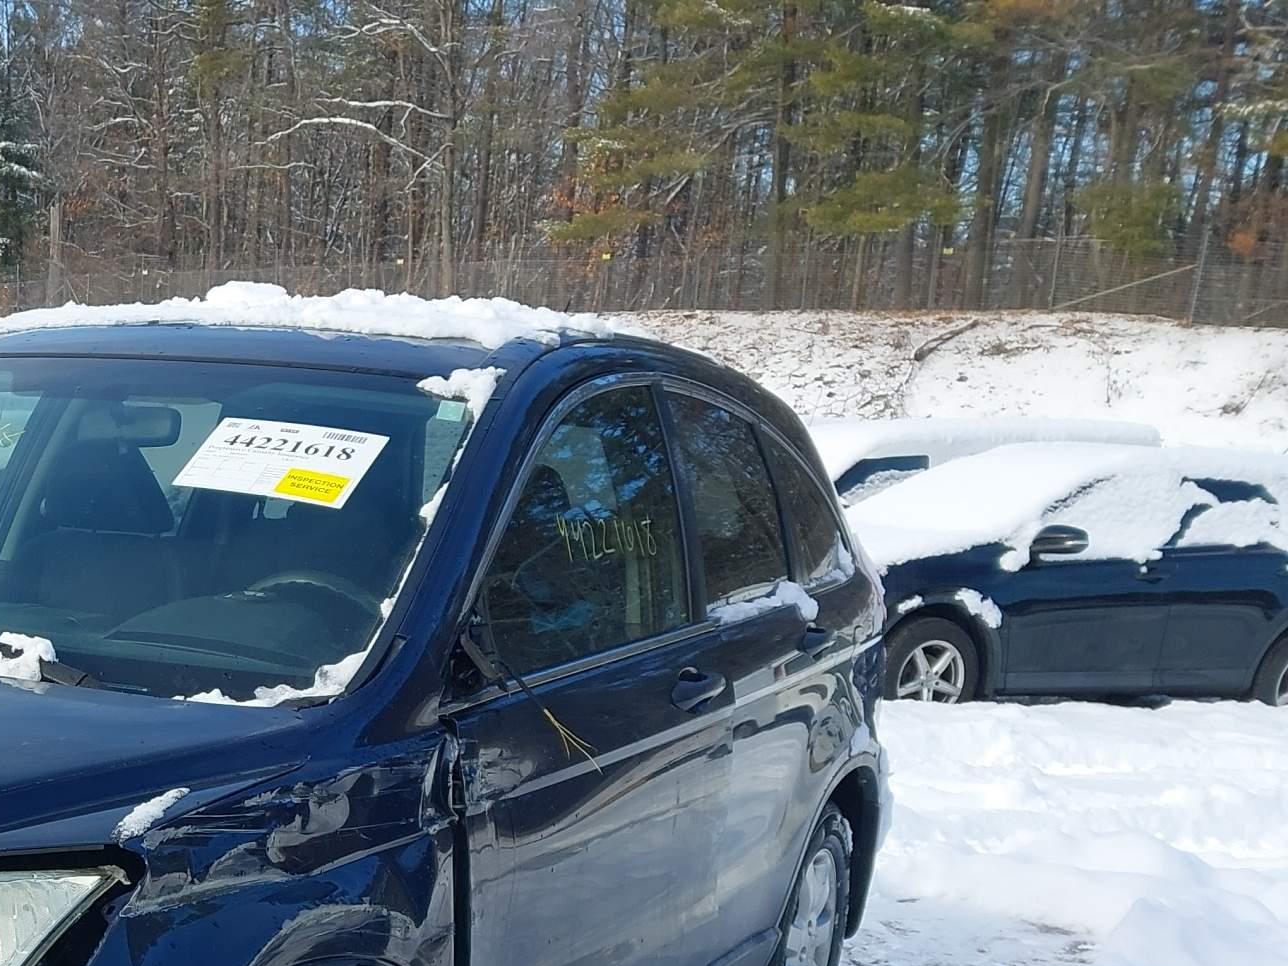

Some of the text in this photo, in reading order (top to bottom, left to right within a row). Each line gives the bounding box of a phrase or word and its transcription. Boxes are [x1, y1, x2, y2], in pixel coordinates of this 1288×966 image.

[224, 433, 356, 461] 44221618
[287, 473, 345, 490] INSPECTION
[289, 481, 332, 495] SERVICE
[556, 512, 657, 562] 44221618
